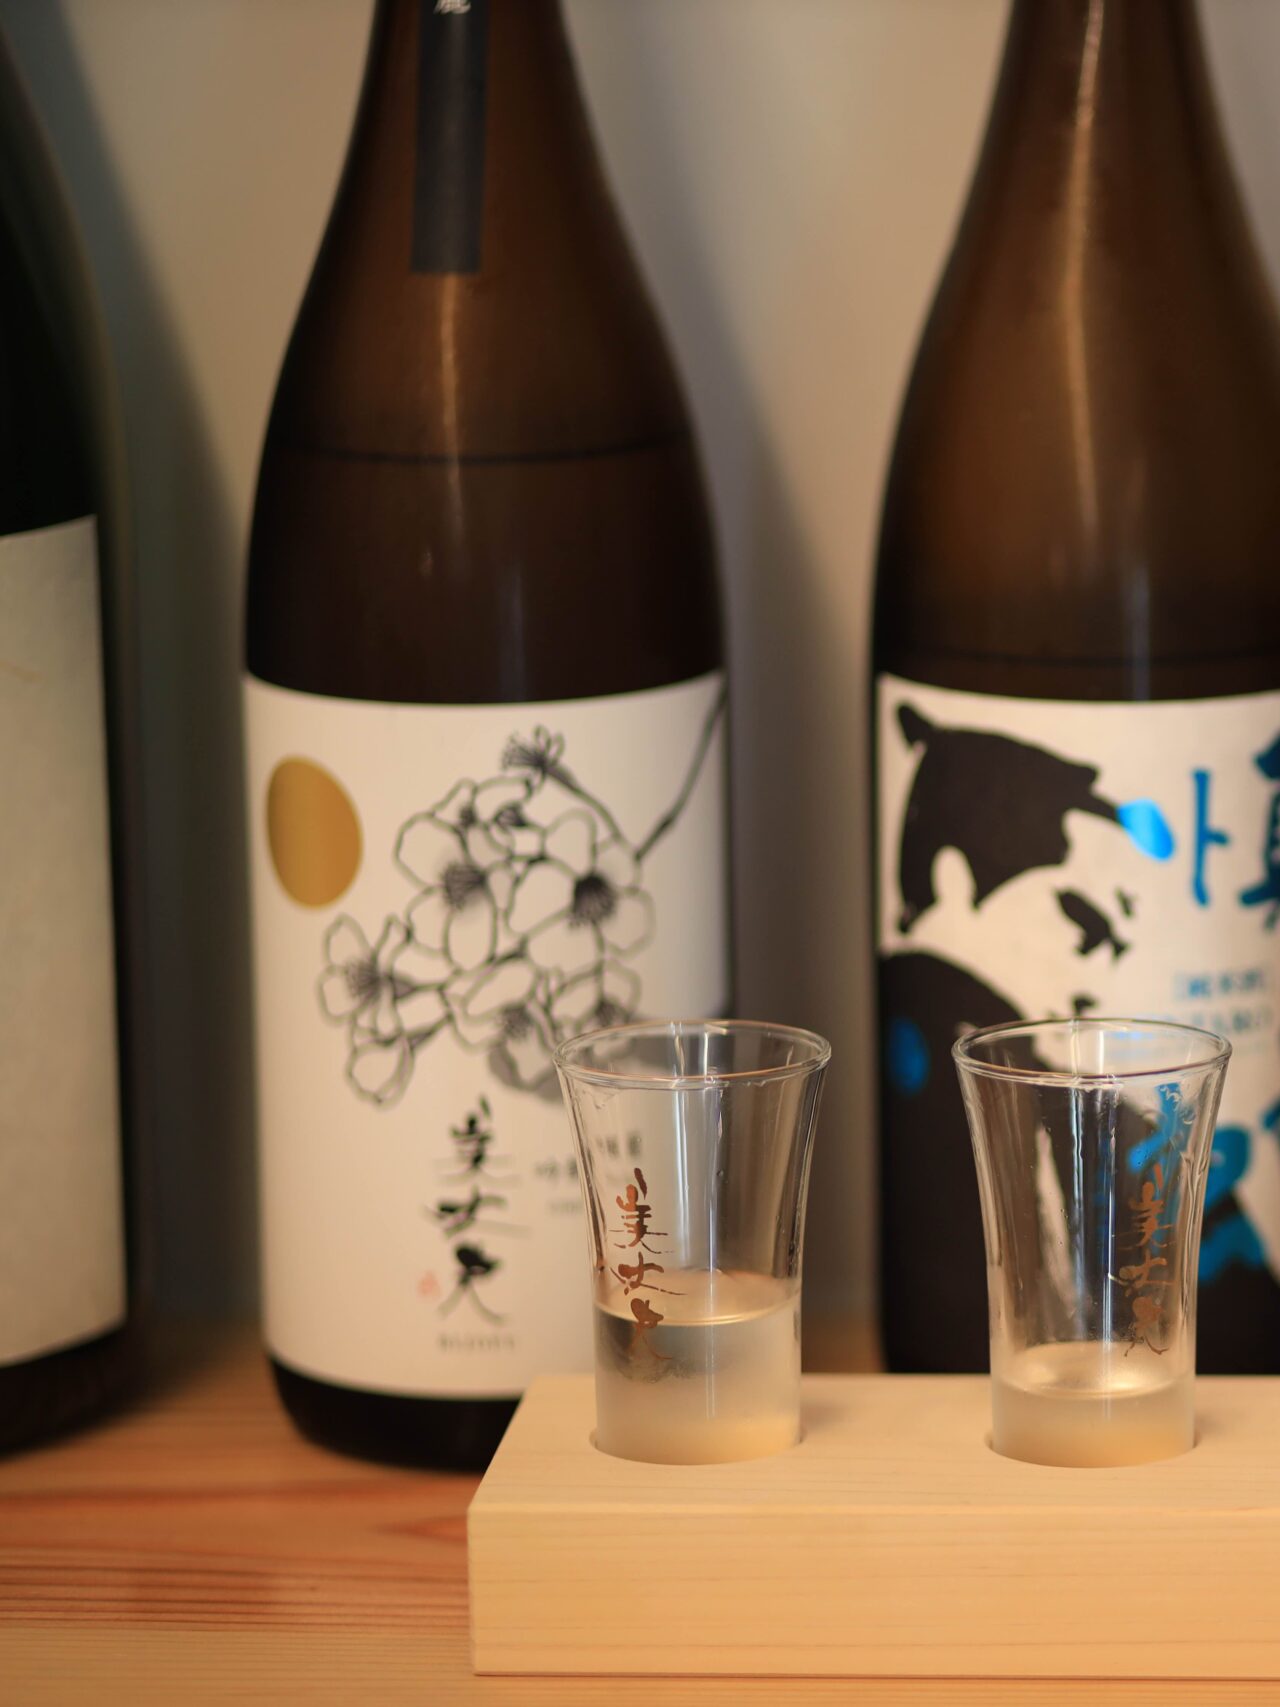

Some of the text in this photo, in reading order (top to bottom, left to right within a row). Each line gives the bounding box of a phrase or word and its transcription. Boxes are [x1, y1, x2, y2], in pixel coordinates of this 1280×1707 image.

[422, 1099, 531, 1326] 美丈夫
[608, 1168, 688, 1360] 美丈夫
